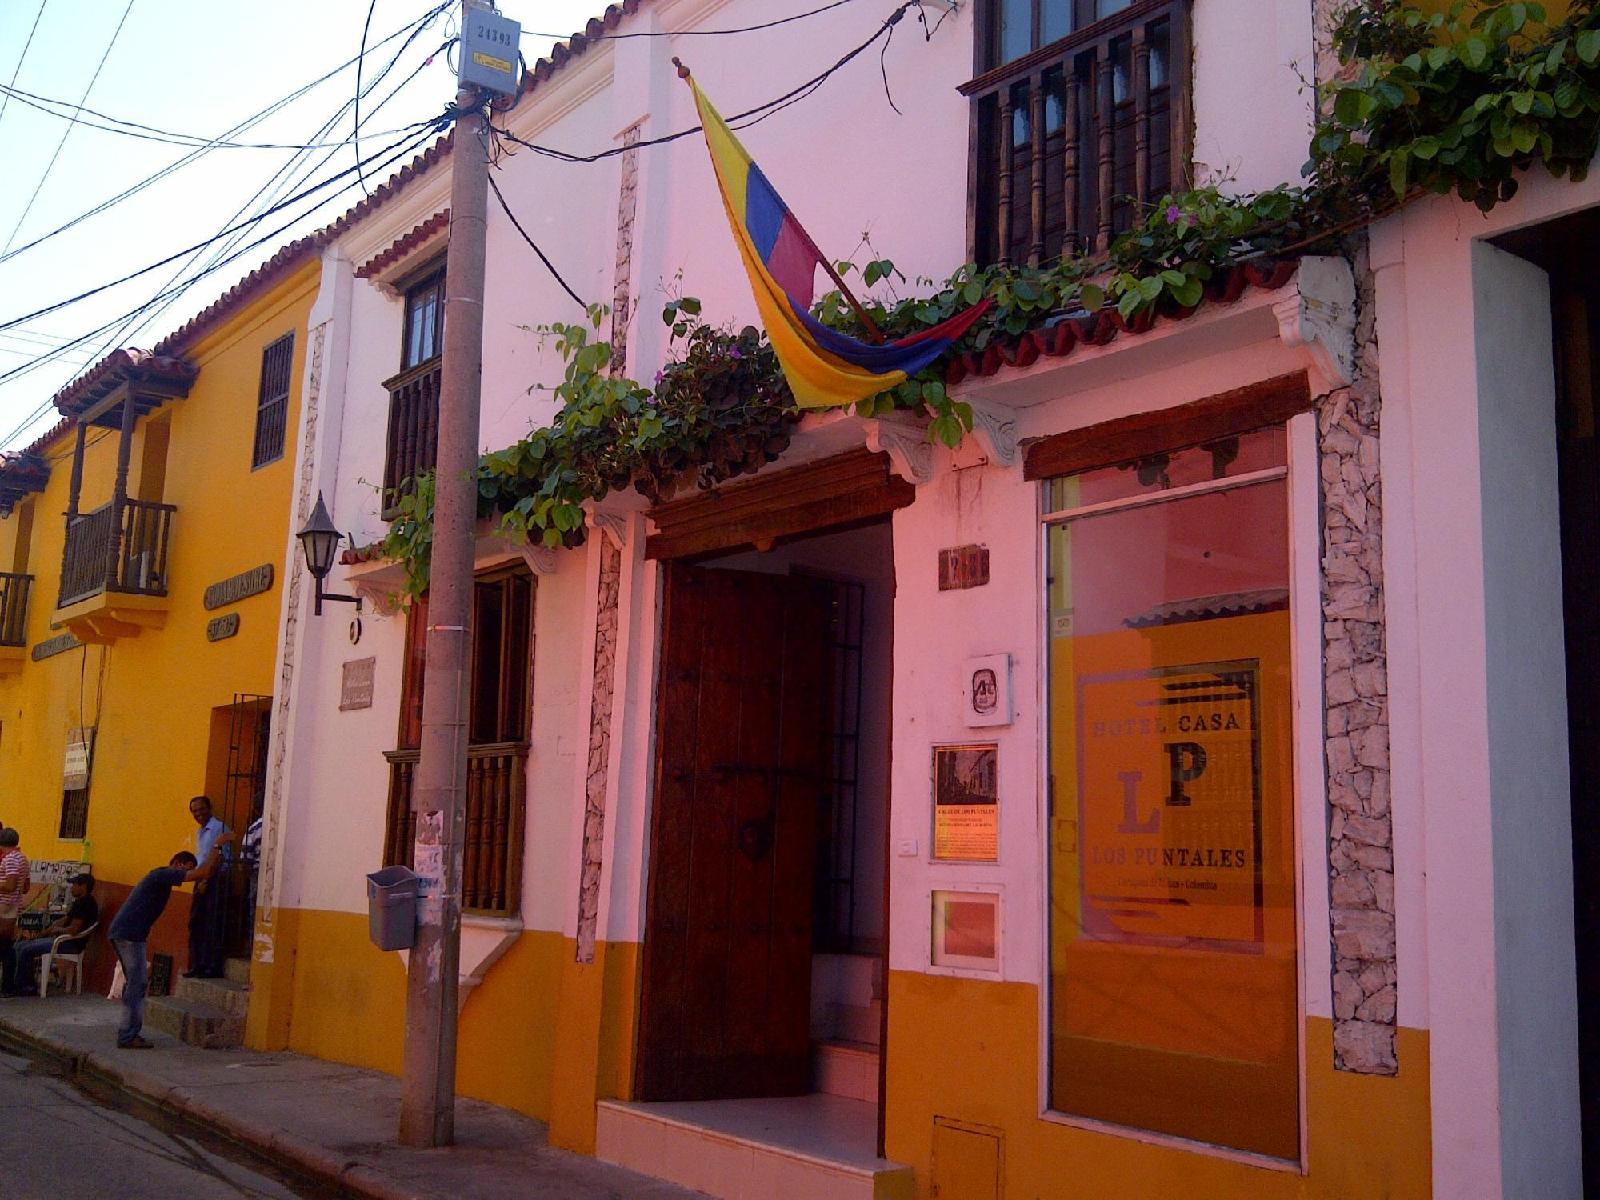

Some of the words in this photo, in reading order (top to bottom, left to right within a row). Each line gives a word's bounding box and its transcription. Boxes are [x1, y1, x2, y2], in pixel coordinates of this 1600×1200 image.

[1178, 712, 1240, 732] CASA
[1118, 771, 1161, 833] L
[1164, 742, 1207, 806] P
[1093, 848, 1127, 865] LOS
[1136, 848, 1246, 868] PUNTALES
